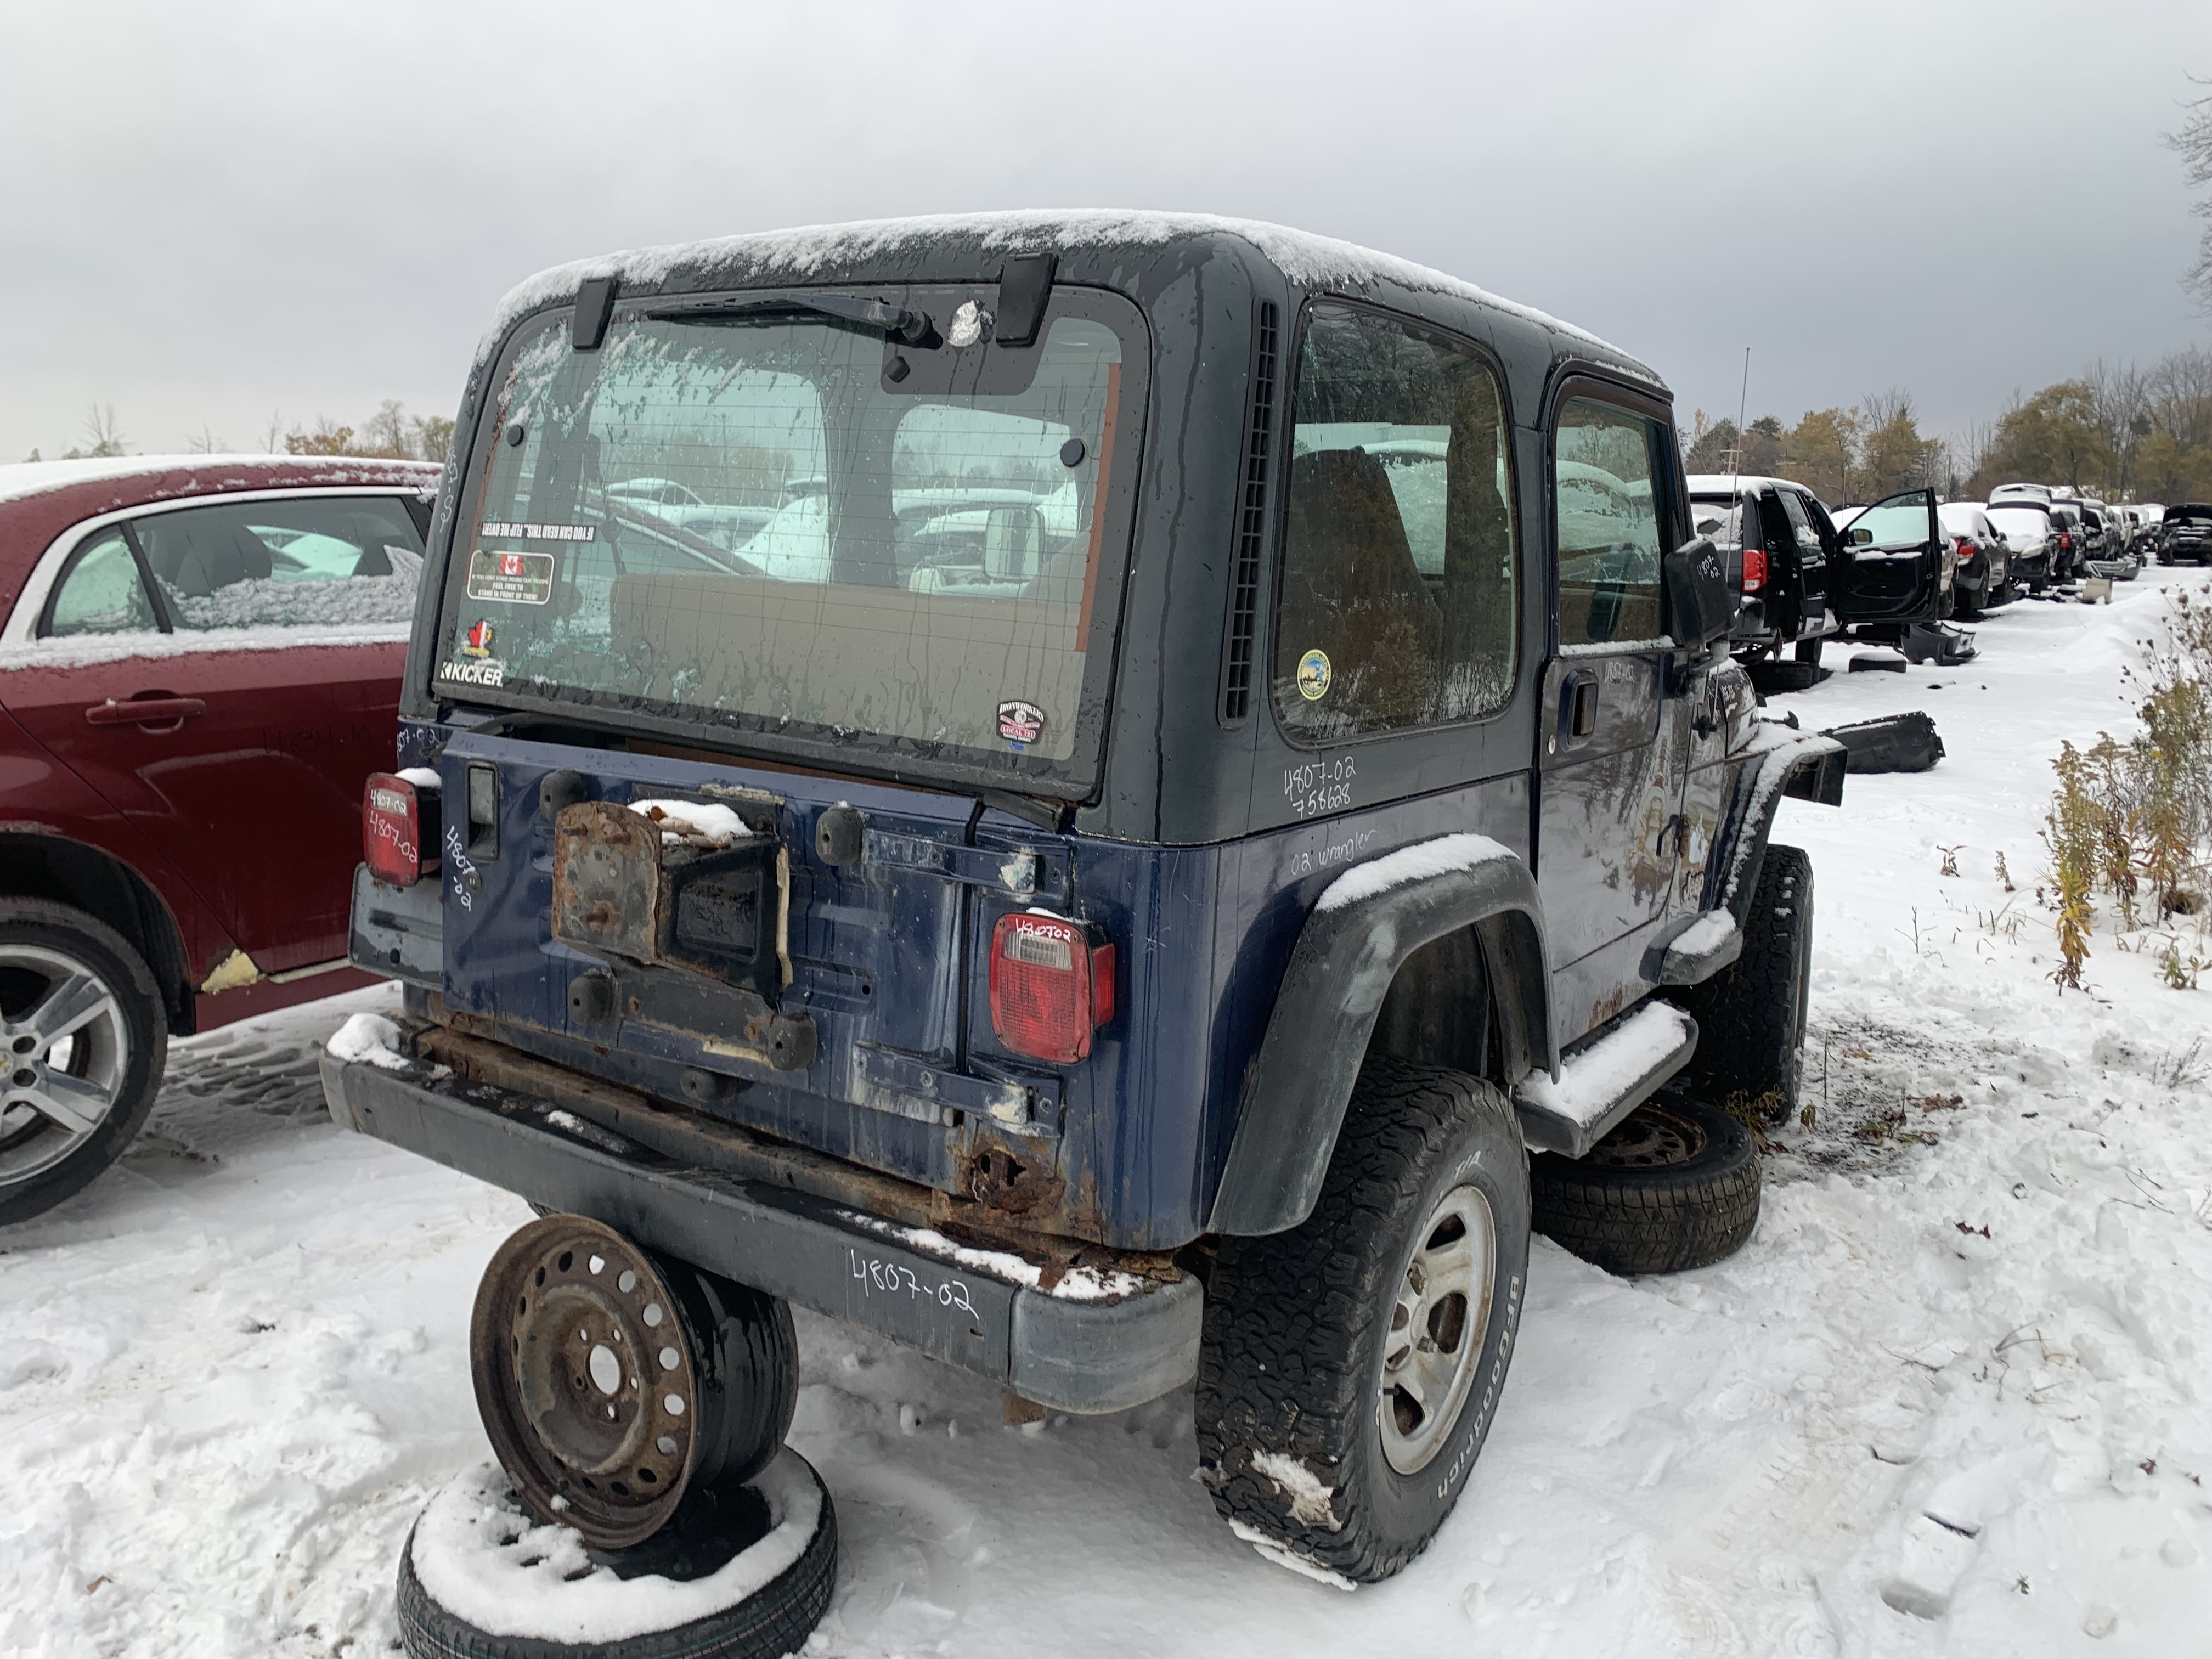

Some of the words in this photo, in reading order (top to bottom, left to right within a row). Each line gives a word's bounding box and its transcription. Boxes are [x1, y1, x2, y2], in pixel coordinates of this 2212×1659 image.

[500, 522, 510, 537] ME
[509, 523, 523, 538] FLIP
[542, 524, 559, 539] READ
[558, 525, 573, 540] CAN
[573, 526, 586, 541] YOU
[586, 526, 594, 541] IF
[1709, 566, 1720, 579] 02
[478, 589, 493, 597] STAND
[499, 590, 515, 599] FRONT
[493, 582, 504, 590] FEEL
[505, 582, 516, 591] FREE
[517, 583, 524, 591] TO
[450, 662, 503, 687] KICKER
[999, 701, 1045, 723] IRONWORKERS
[1002, 725, 1022, 736] LOCAL
[1284, 755, 1356, 802] 4807-02
[1292, 782, 1351, 819] 758628
[369, 810, 418, 864] 4807-02
[1291, 852, 1312, 876] 02
[1683, 872, 1705, 901] Jeep
[850, 1248, 981, 1322] 4807-02
